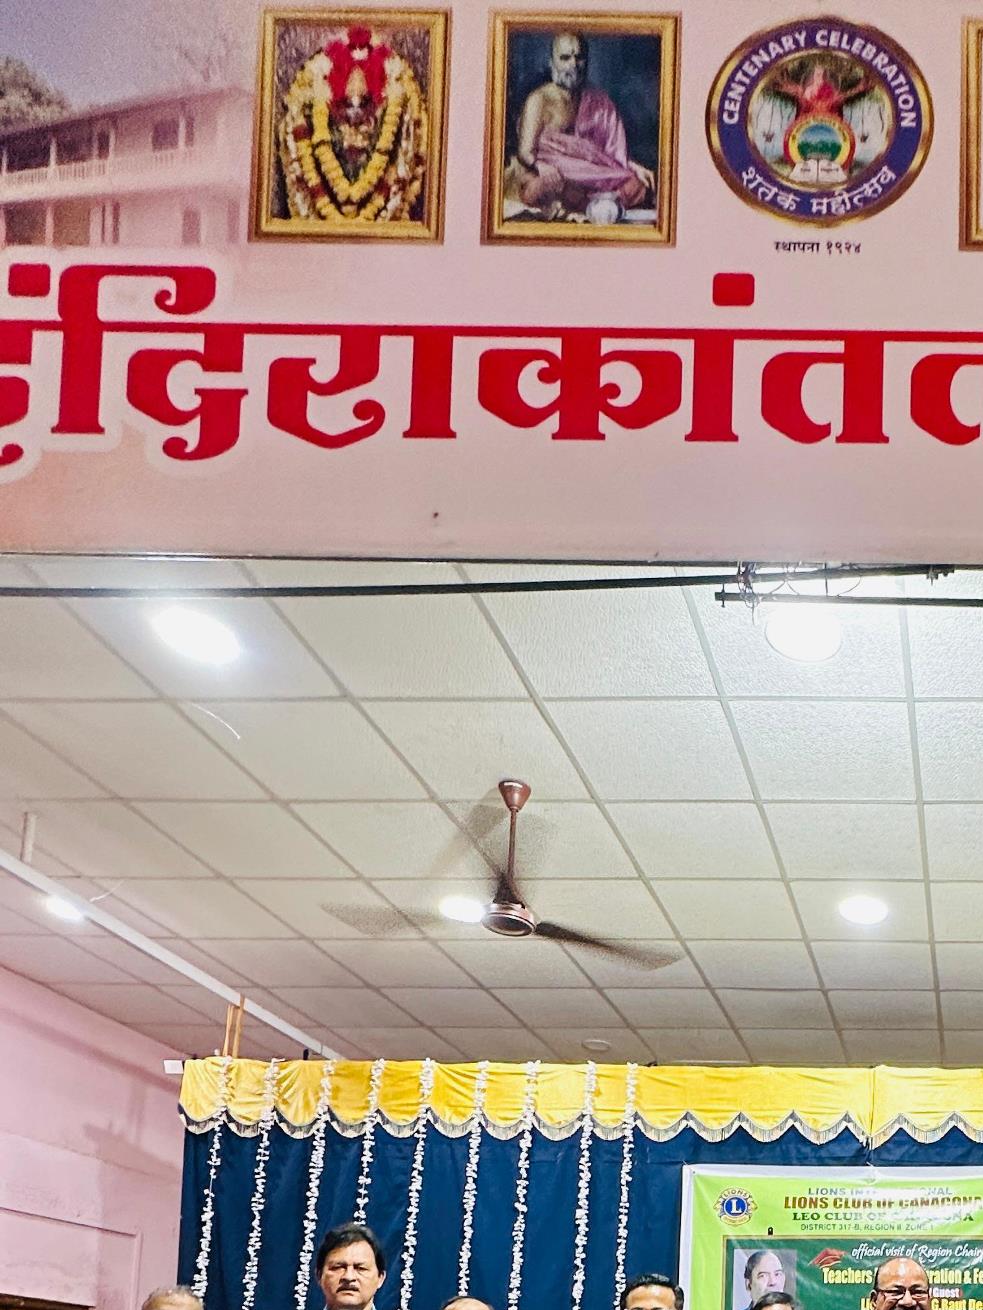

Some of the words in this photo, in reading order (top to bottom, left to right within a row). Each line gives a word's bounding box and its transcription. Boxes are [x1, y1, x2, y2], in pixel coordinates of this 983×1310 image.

[722, 30, 808, 125] CENTENARY
[815, 29, 917, 128] CELEBRATION
[774, 240, 820, 253] स्थापना
[808, 1187, 846, 1196] LIONS
[784, 1196, 829, 1209] LIONS
[832, 1197, 872, 1209] CLUB
[792, 1212, 821, 1221] LEO
[824, 1212, 863, 1221] CLUB
[800, 1223, 837, 1231] DISTRICT
[863, 1223, 895, 1231] REGION
[851, 1243, 884, 1258] official
[885, 1245, 904, 1257] visit
[905, 1243, 917, 1257] of
[918, 1245, 952, 1262] Region
[822, 1268, 873, 1284] Teachers
[933, 1287, 960, 1298] Guest
